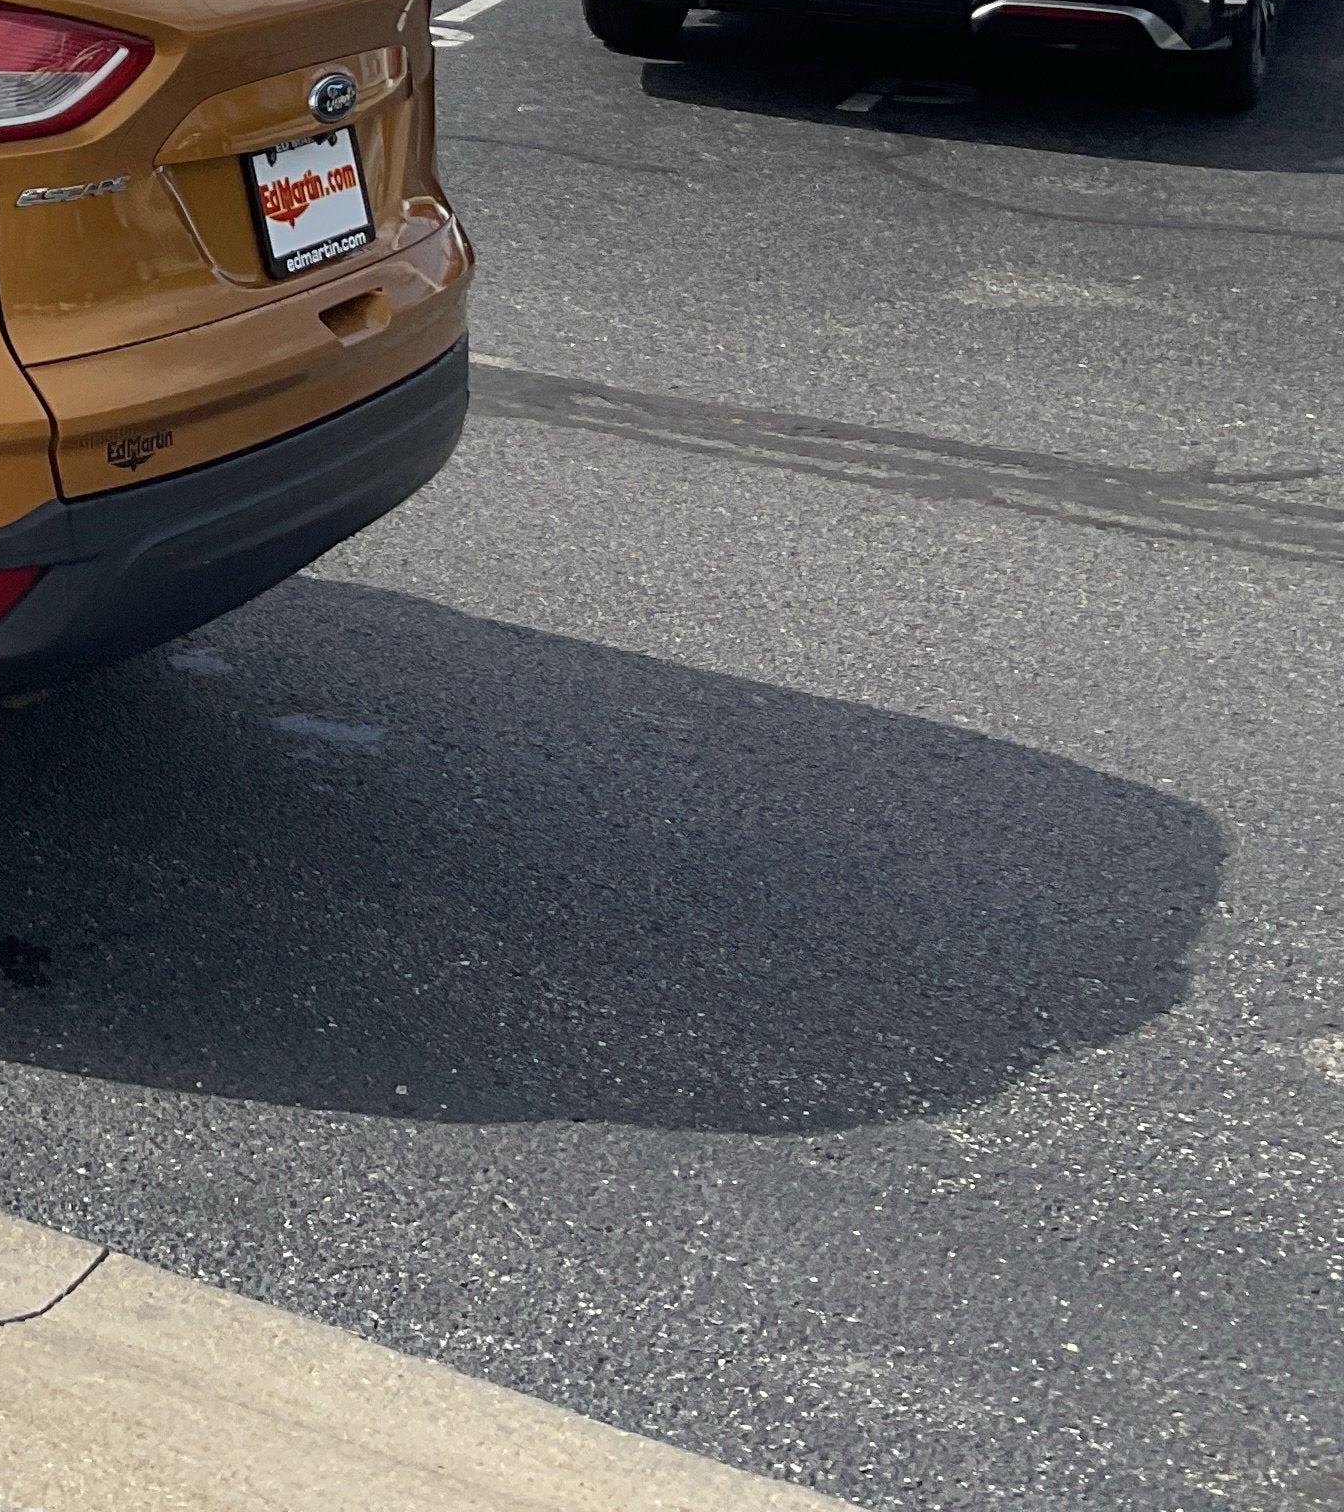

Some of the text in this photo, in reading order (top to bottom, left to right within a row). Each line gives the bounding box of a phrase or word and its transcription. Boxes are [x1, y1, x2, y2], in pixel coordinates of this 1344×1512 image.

[258, 163, 357, 213] EdMartin.com
[286, 230, 367, 273] edmartin.com
[106, 429, 174, 463] EdMartin
